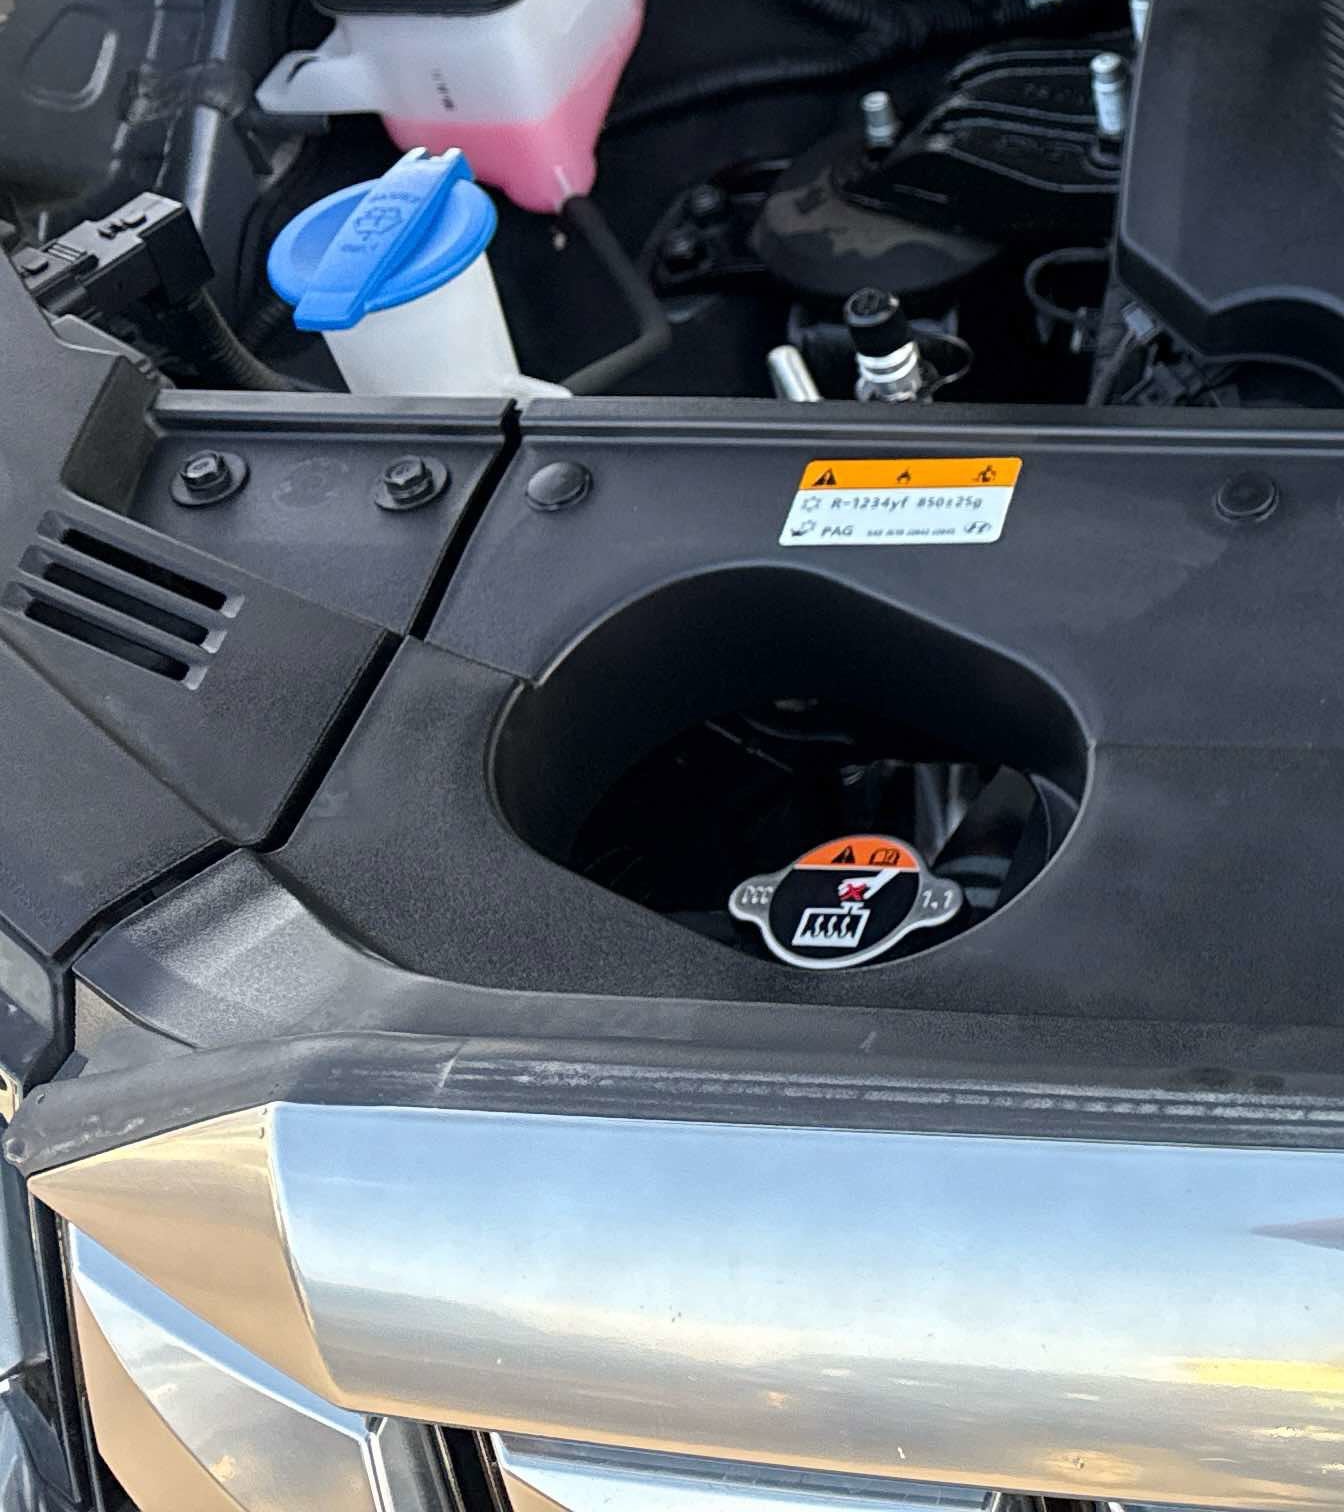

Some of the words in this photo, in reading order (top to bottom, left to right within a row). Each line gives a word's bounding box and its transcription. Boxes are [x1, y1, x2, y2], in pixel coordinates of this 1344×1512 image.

[830, 496, 910, 512] R-1234yf
[821, 525, 854, 537] PAG
[922, 890, 953, 910] 1.1
